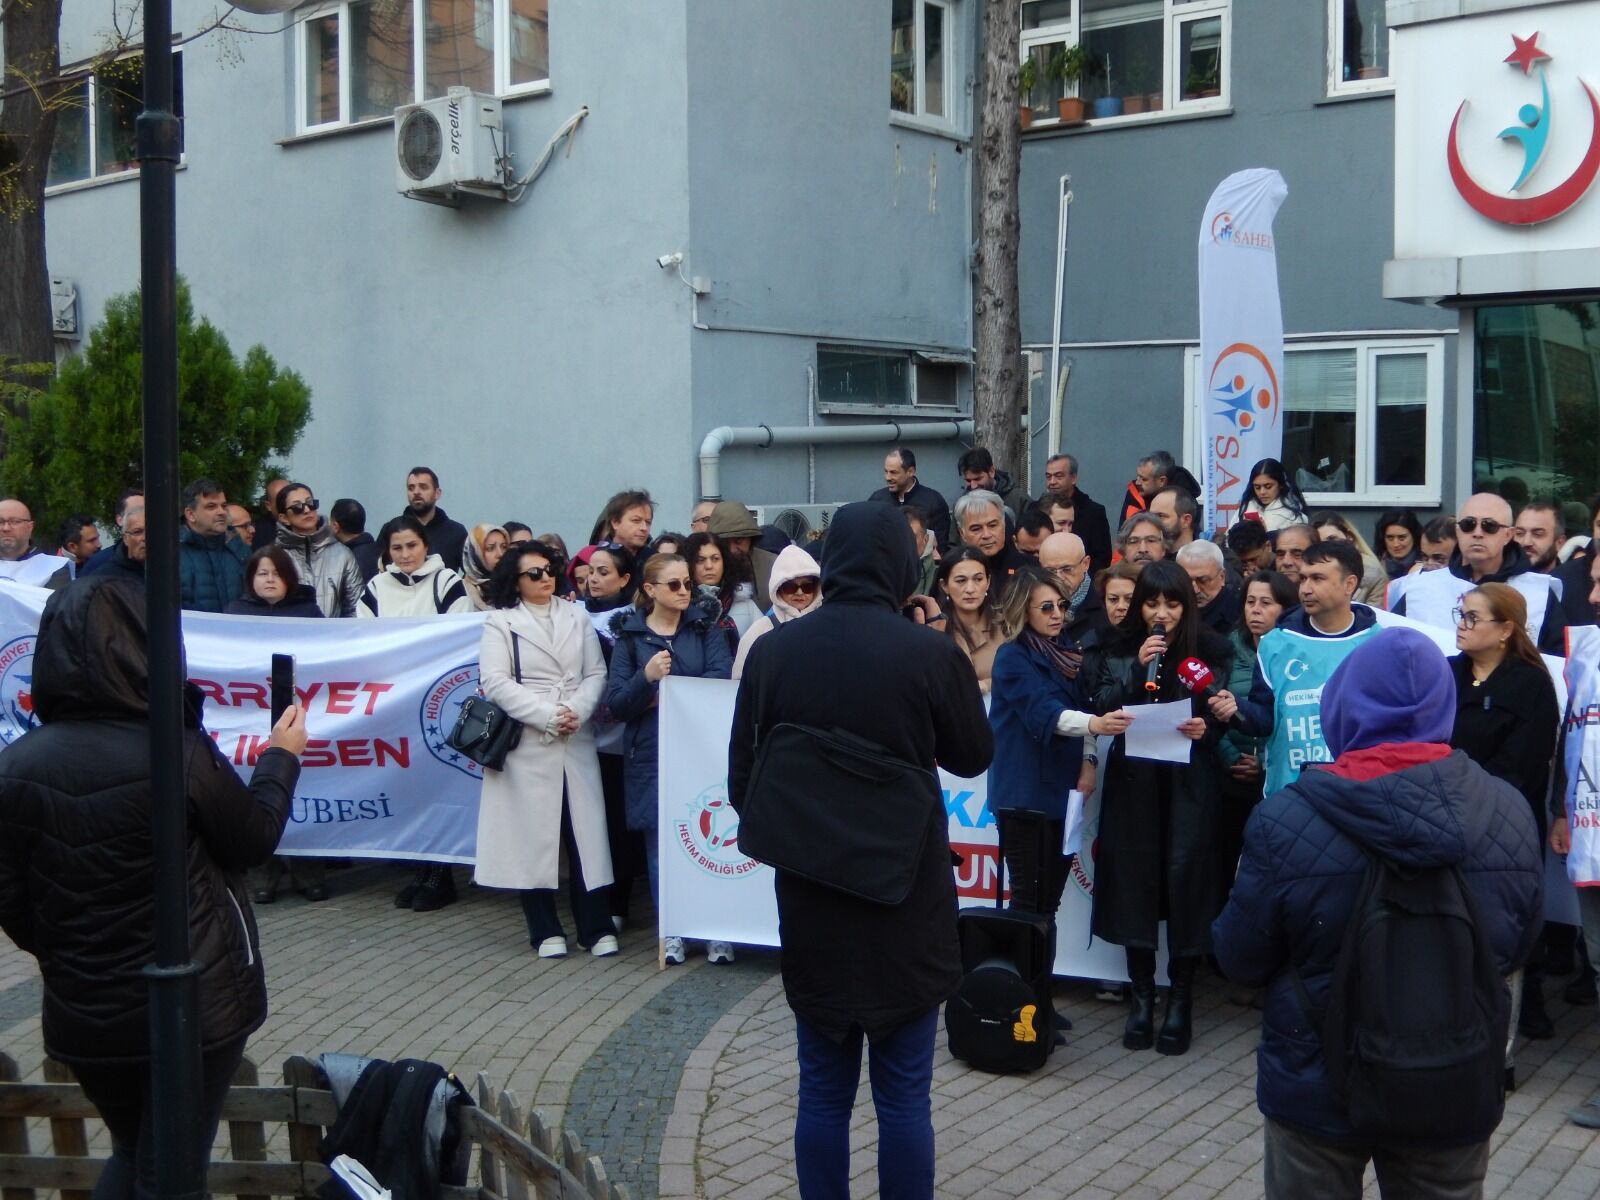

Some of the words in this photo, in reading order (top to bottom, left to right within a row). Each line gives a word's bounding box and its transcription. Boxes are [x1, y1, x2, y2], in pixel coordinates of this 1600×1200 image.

[448, 98, 461, 155] arçelik
[187, 677, 395, 716] RRYET
[426, 670, 471, 720] HÜRRİYET
[678, 823, 699, 859] HEKİM
[698, 856, 735, 876] BİRLİĞİ
